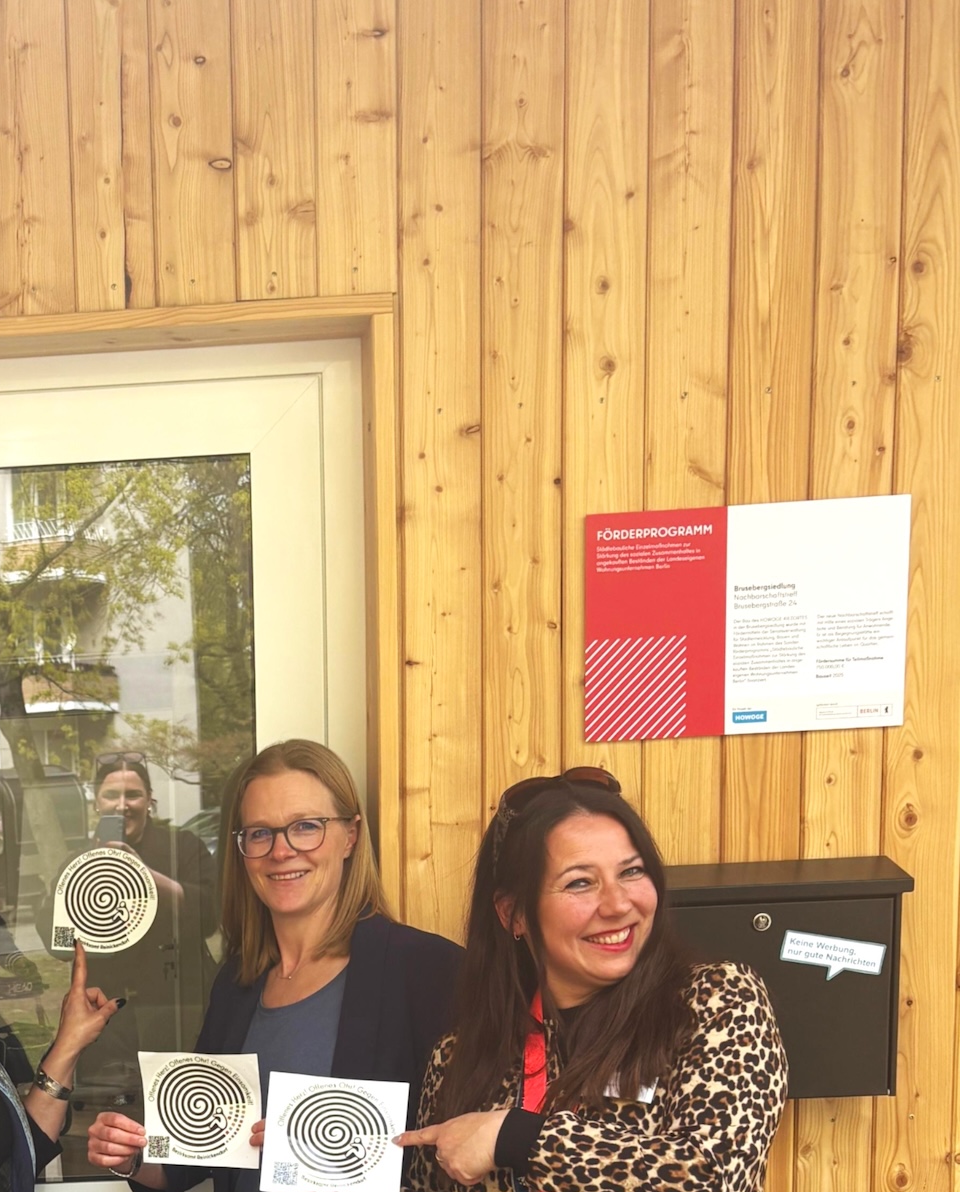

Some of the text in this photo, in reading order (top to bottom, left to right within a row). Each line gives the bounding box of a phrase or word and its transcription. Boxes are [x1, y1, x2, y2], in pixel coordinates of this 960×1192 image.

[597, 524, 712, 541] FÖRDERPROGRAMM
[734, 583, 795, 592] Brusebergsiedlung
[734, 591, 797, 600] Nachbarschaftstreff
[734, 600, 786, 609] Brusebergstraße
[57, 872, 70, 895] Offenes
[69, 858, 84, 872] Herz!
[82, 850, 106, 861] Offenes
[123, 853, 141, 868] Gegen
[790, 938, 813, 948] Keine
[826, 954, 876, 967] Nachrichten
[148, 1078, 160, 1102] Offenes
[157, 1065, 170, 1080] Herz!
[168, 1057, 194, 1068] Offenes
[210, 1060, 232, 1075] Gegen
[232, 1073, 254, 1106] Einsamkeit!
